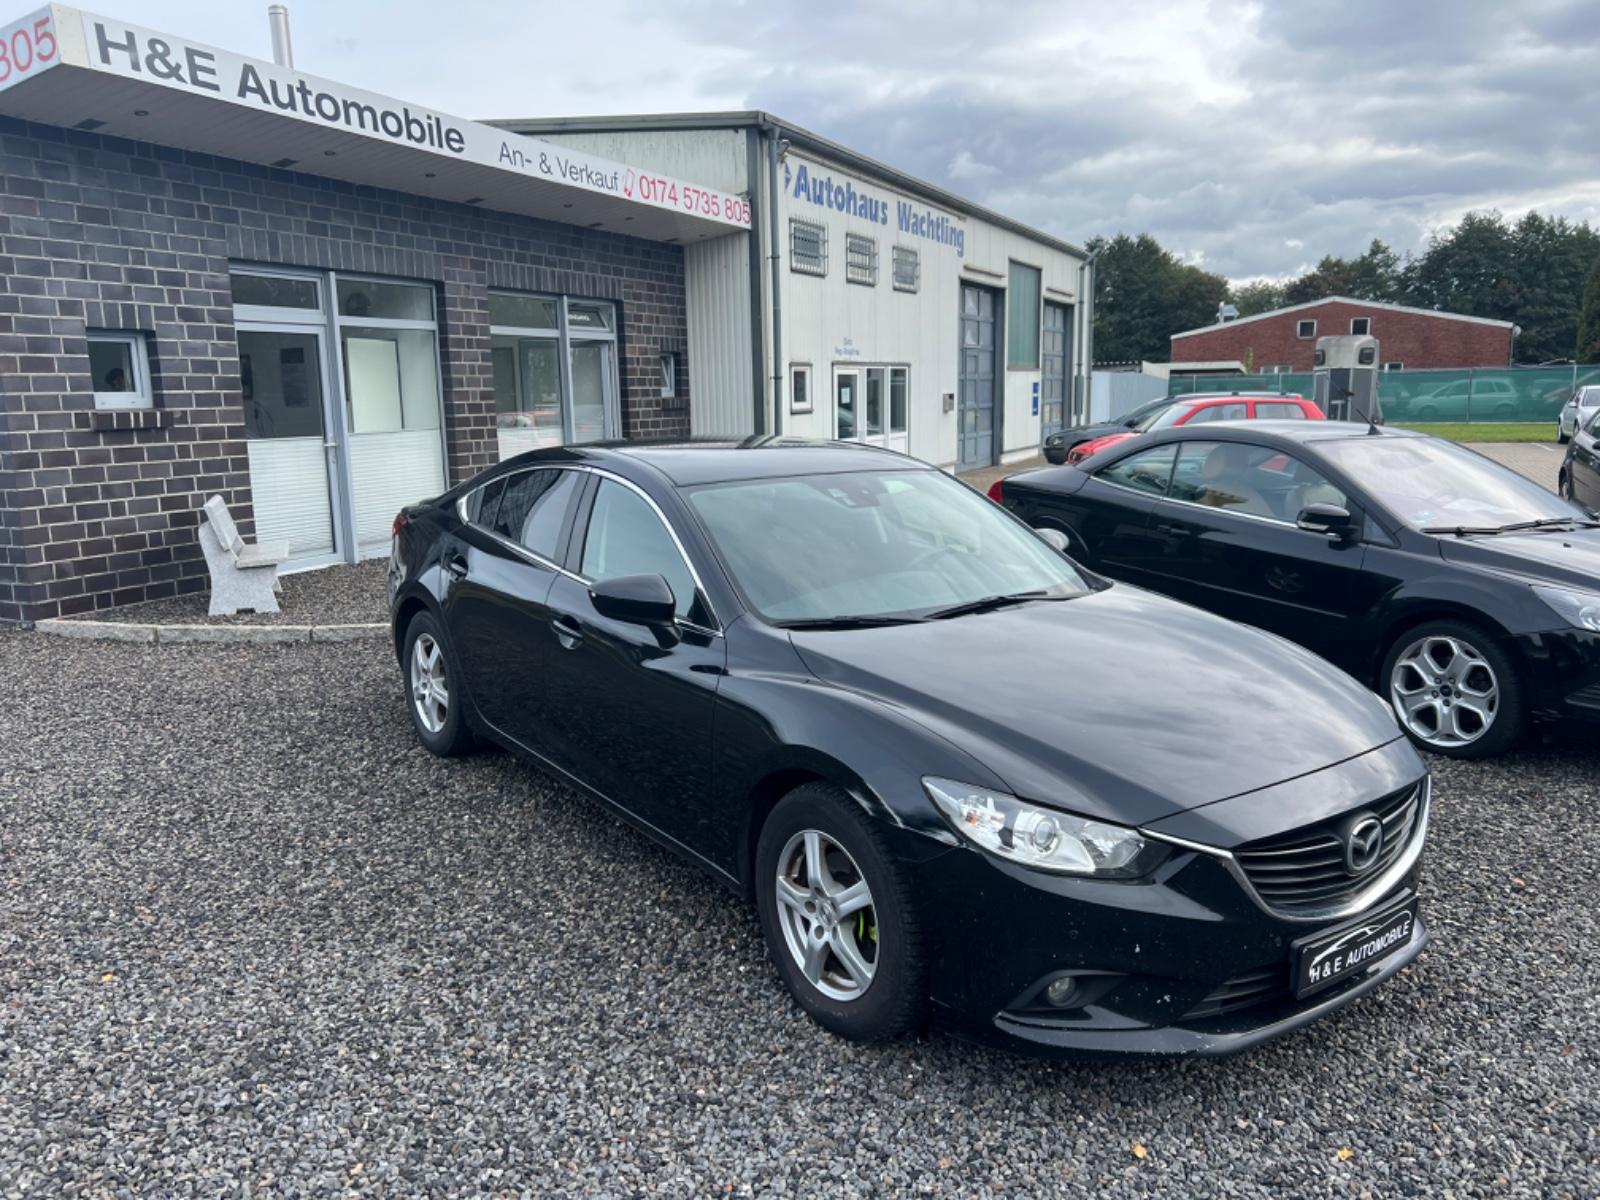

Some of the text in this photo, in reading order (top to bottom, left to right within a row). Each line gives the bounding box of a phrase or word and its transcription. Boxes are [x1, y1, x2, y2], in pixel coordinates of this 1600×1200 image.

[94, 22, 465, 154] H&E Automobile
[499, 141, 751, 225] An- & Verkauf 0174 5735 805
[793, 164, 965, 258] Autohaus Wachtling
[1334, 956, 1343, 973] E
[1346, 920, 1411, 967] AUTOMOBILE
